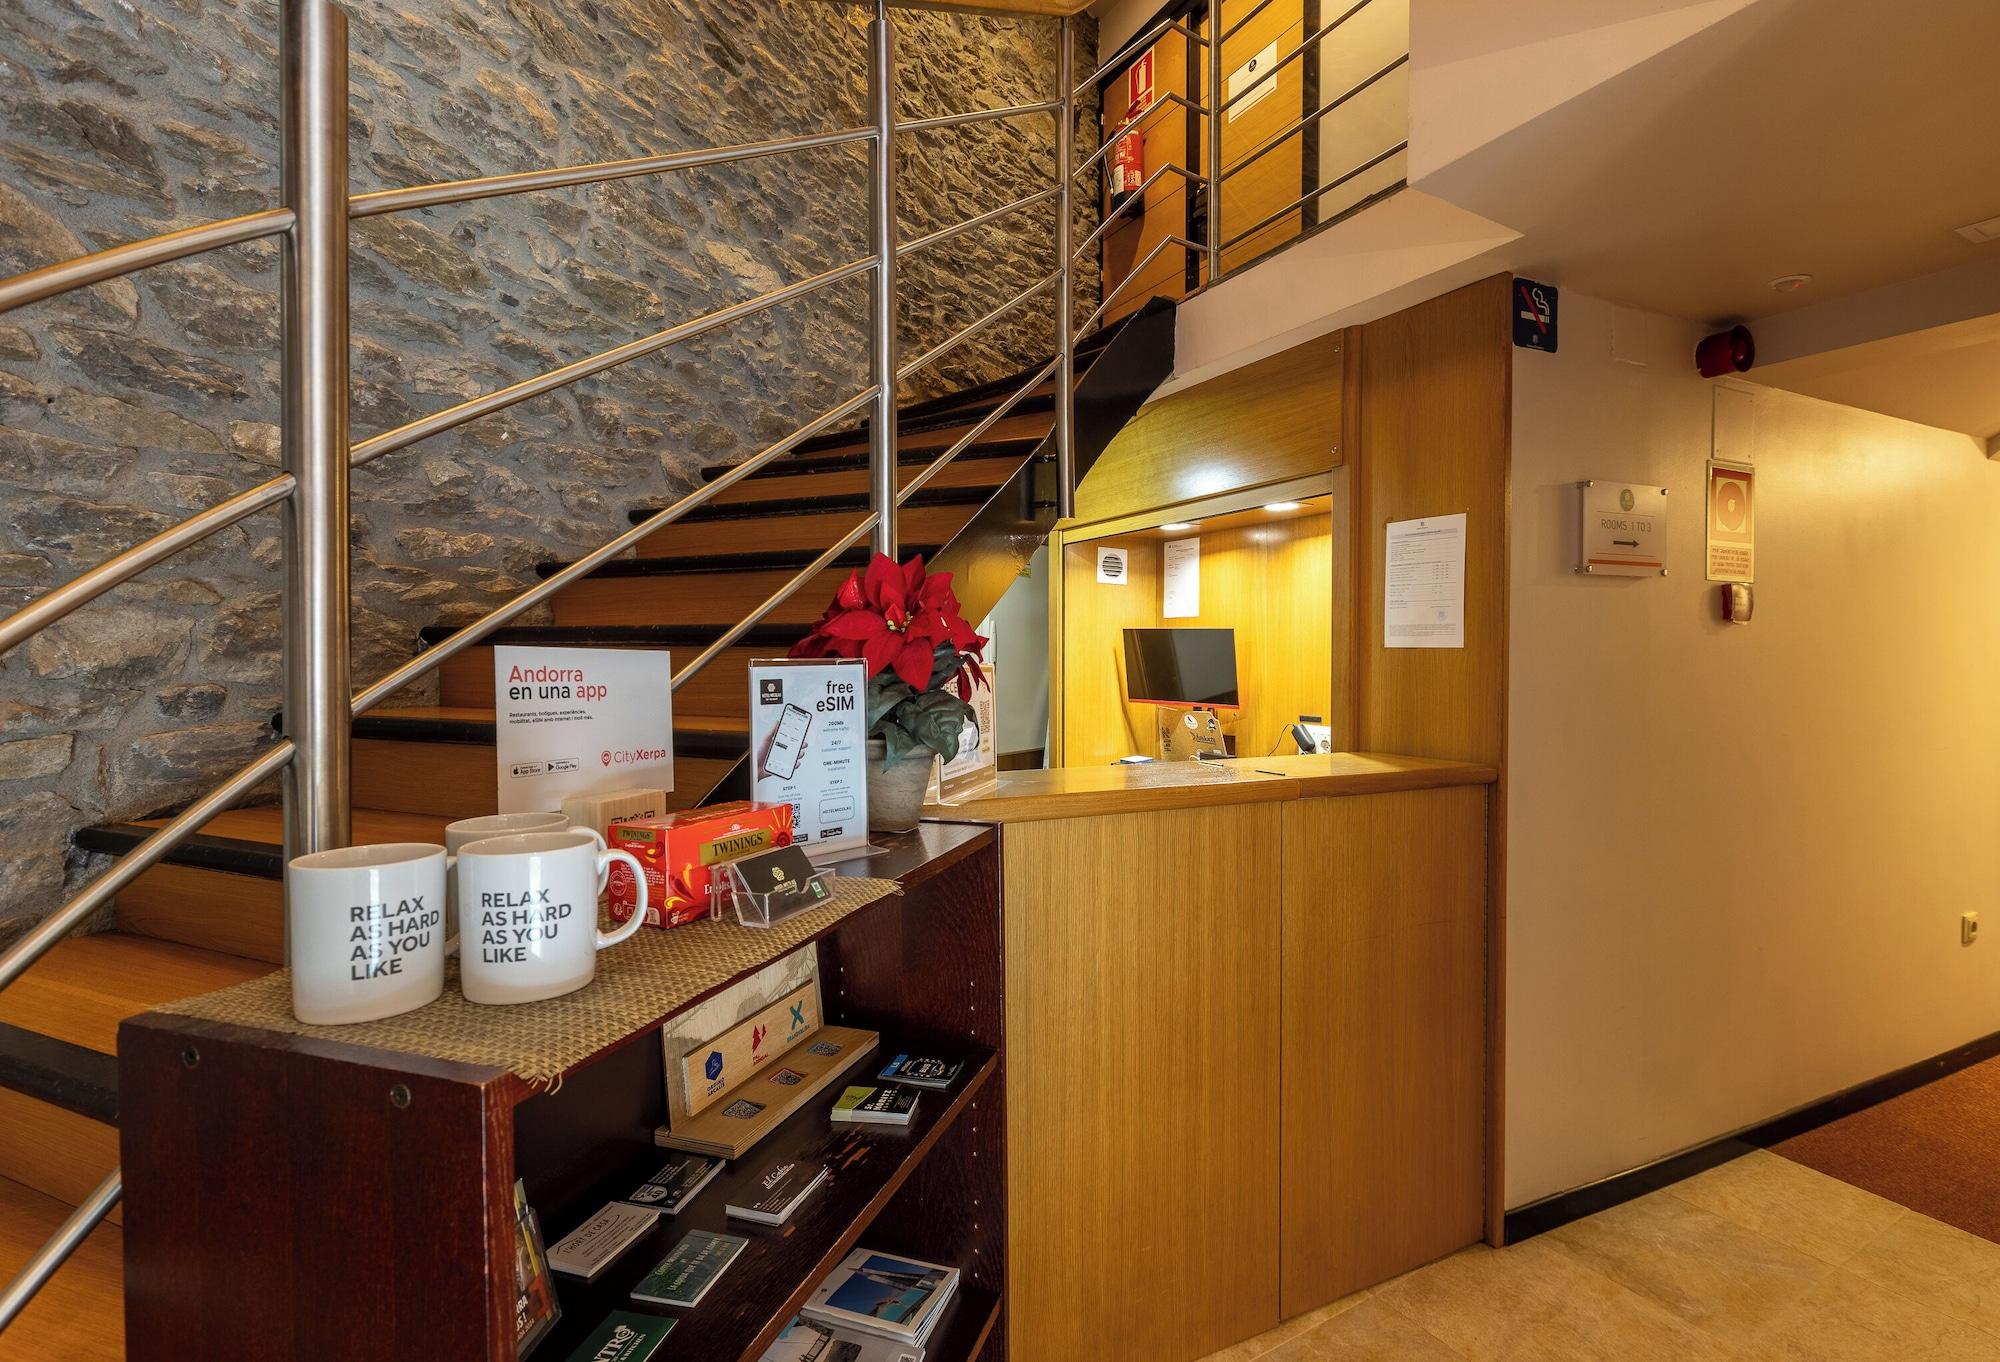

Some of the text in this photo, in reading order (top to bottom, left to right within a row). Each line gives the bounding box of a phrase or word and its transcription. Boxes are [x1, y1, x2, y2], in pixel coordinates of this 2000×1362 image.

[1600, 518, 1628, 531] ROOMS
[1636, 521, 1646, 532] TO
[1646, 522, 1652, 533] 3
[509, 665, 583, 683] Andorra
[509, 684, 607, 701] en una app
[826, 680, 854, 694] free
[816, 695, 854, 712] eSIM
[614, 748, 666, 764] CityXerpa
[622, 829, 652, 840] TWININGS
[712, 832, 763, 857] TWININGS
[481, 888, 550, 908] RELAX
[350, 895, 424, 923] RELAX
[482, 903, 572, 927] AS HARD
[350, 910, 440, 942] AS HARD
[482, 924, 559, 946] AS YOU
[350, 931, 431, 962] AS YOU
[482, 947, 527, 964] LIKE
[351, 958, 403, 981] LIKE
